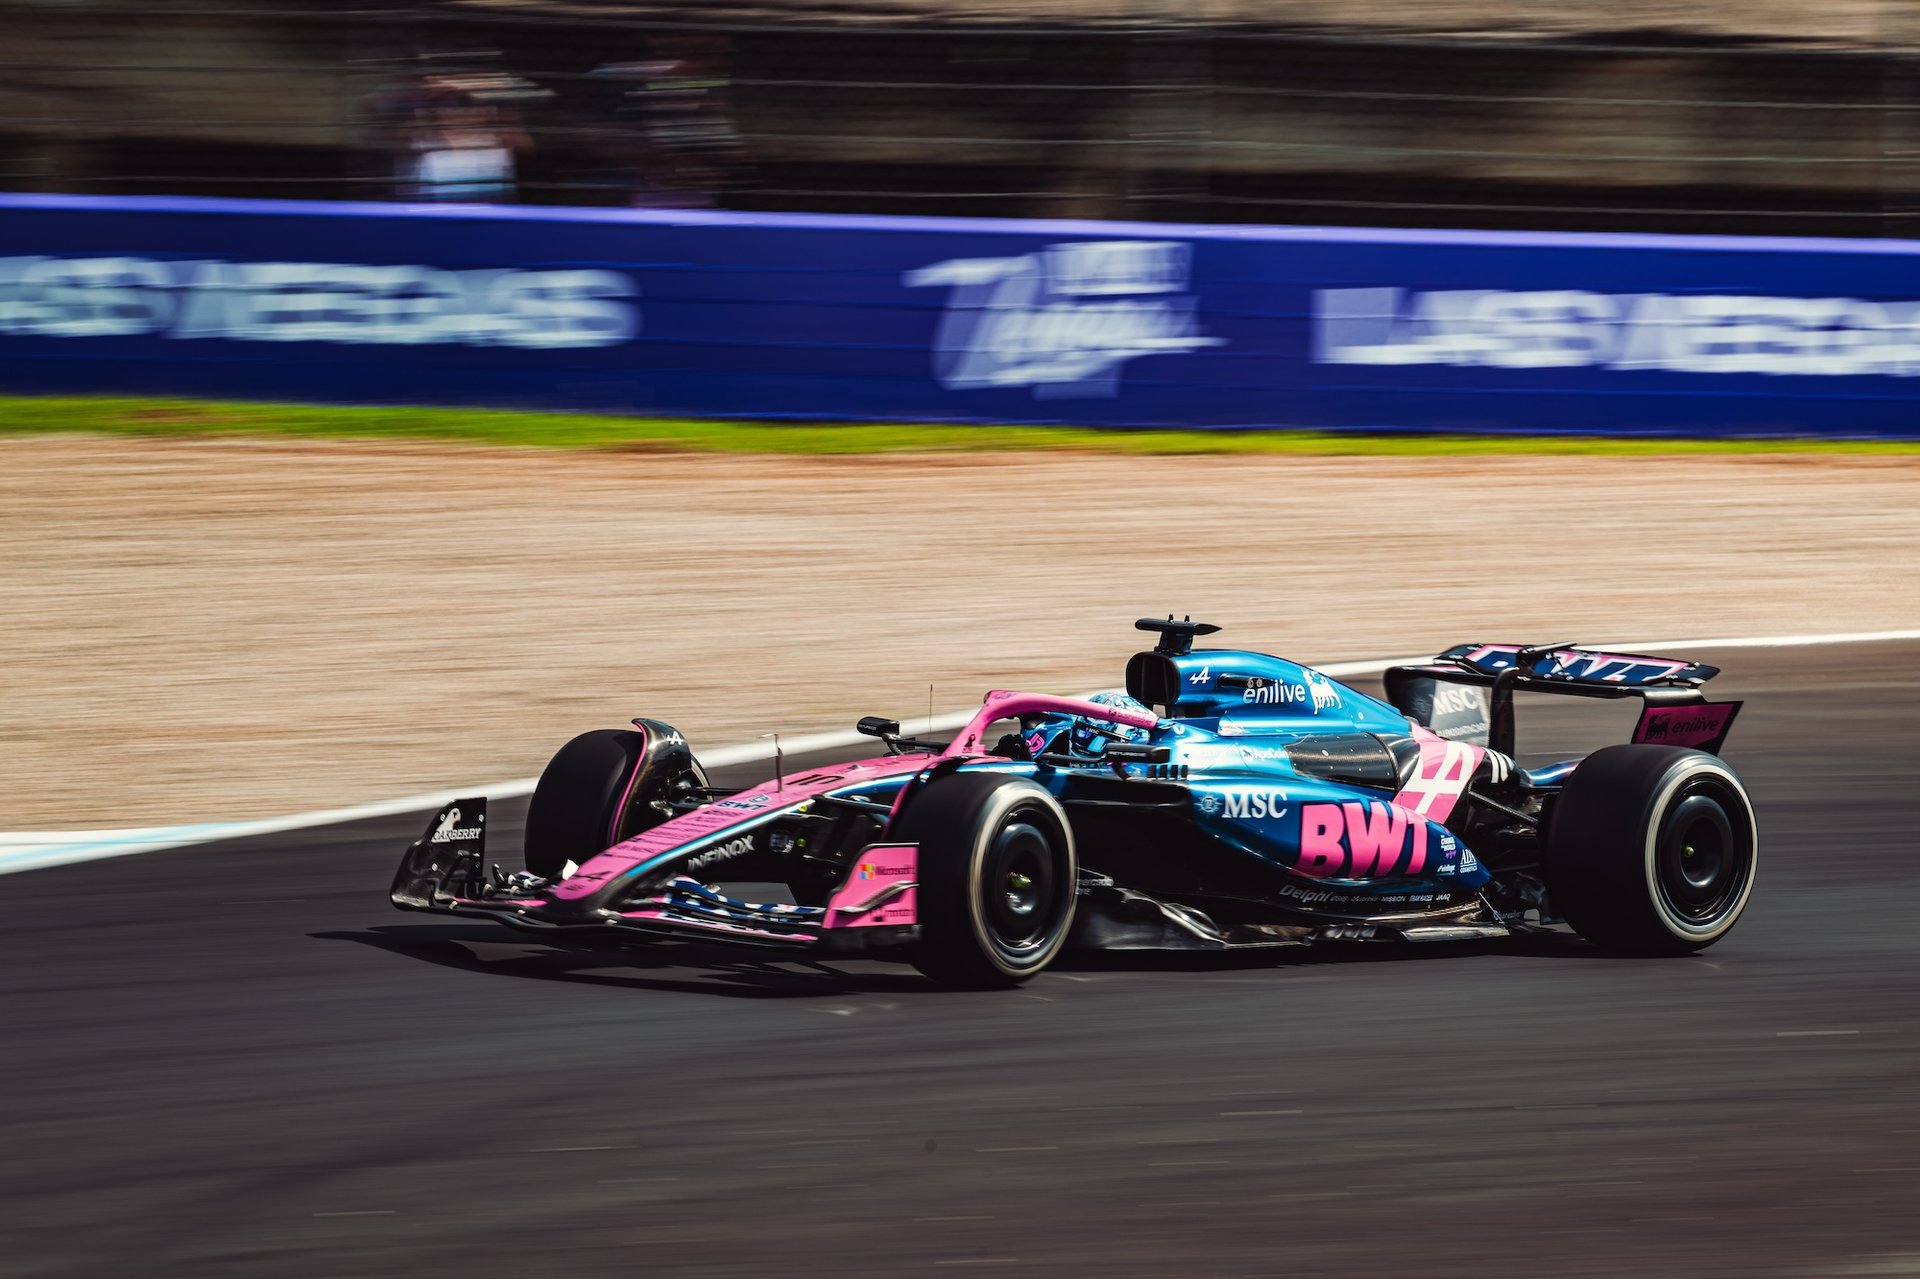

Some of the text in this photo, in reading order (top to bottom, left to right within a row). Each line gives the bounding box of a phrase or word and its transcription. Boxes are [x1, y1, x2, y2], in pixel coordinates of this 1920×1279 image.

[1243, 679, 1306, 704] enilive
[1433, 687, 1478, 716] MSC
[1672, 717, 1719, 734] enilive
[1221, 790, 1288, 819] MSC
[687, 834, 755, 872] INFINOX
[1288, 801, 1430, 879] BWT
[1280, 885, 1333, 903] Delphi
